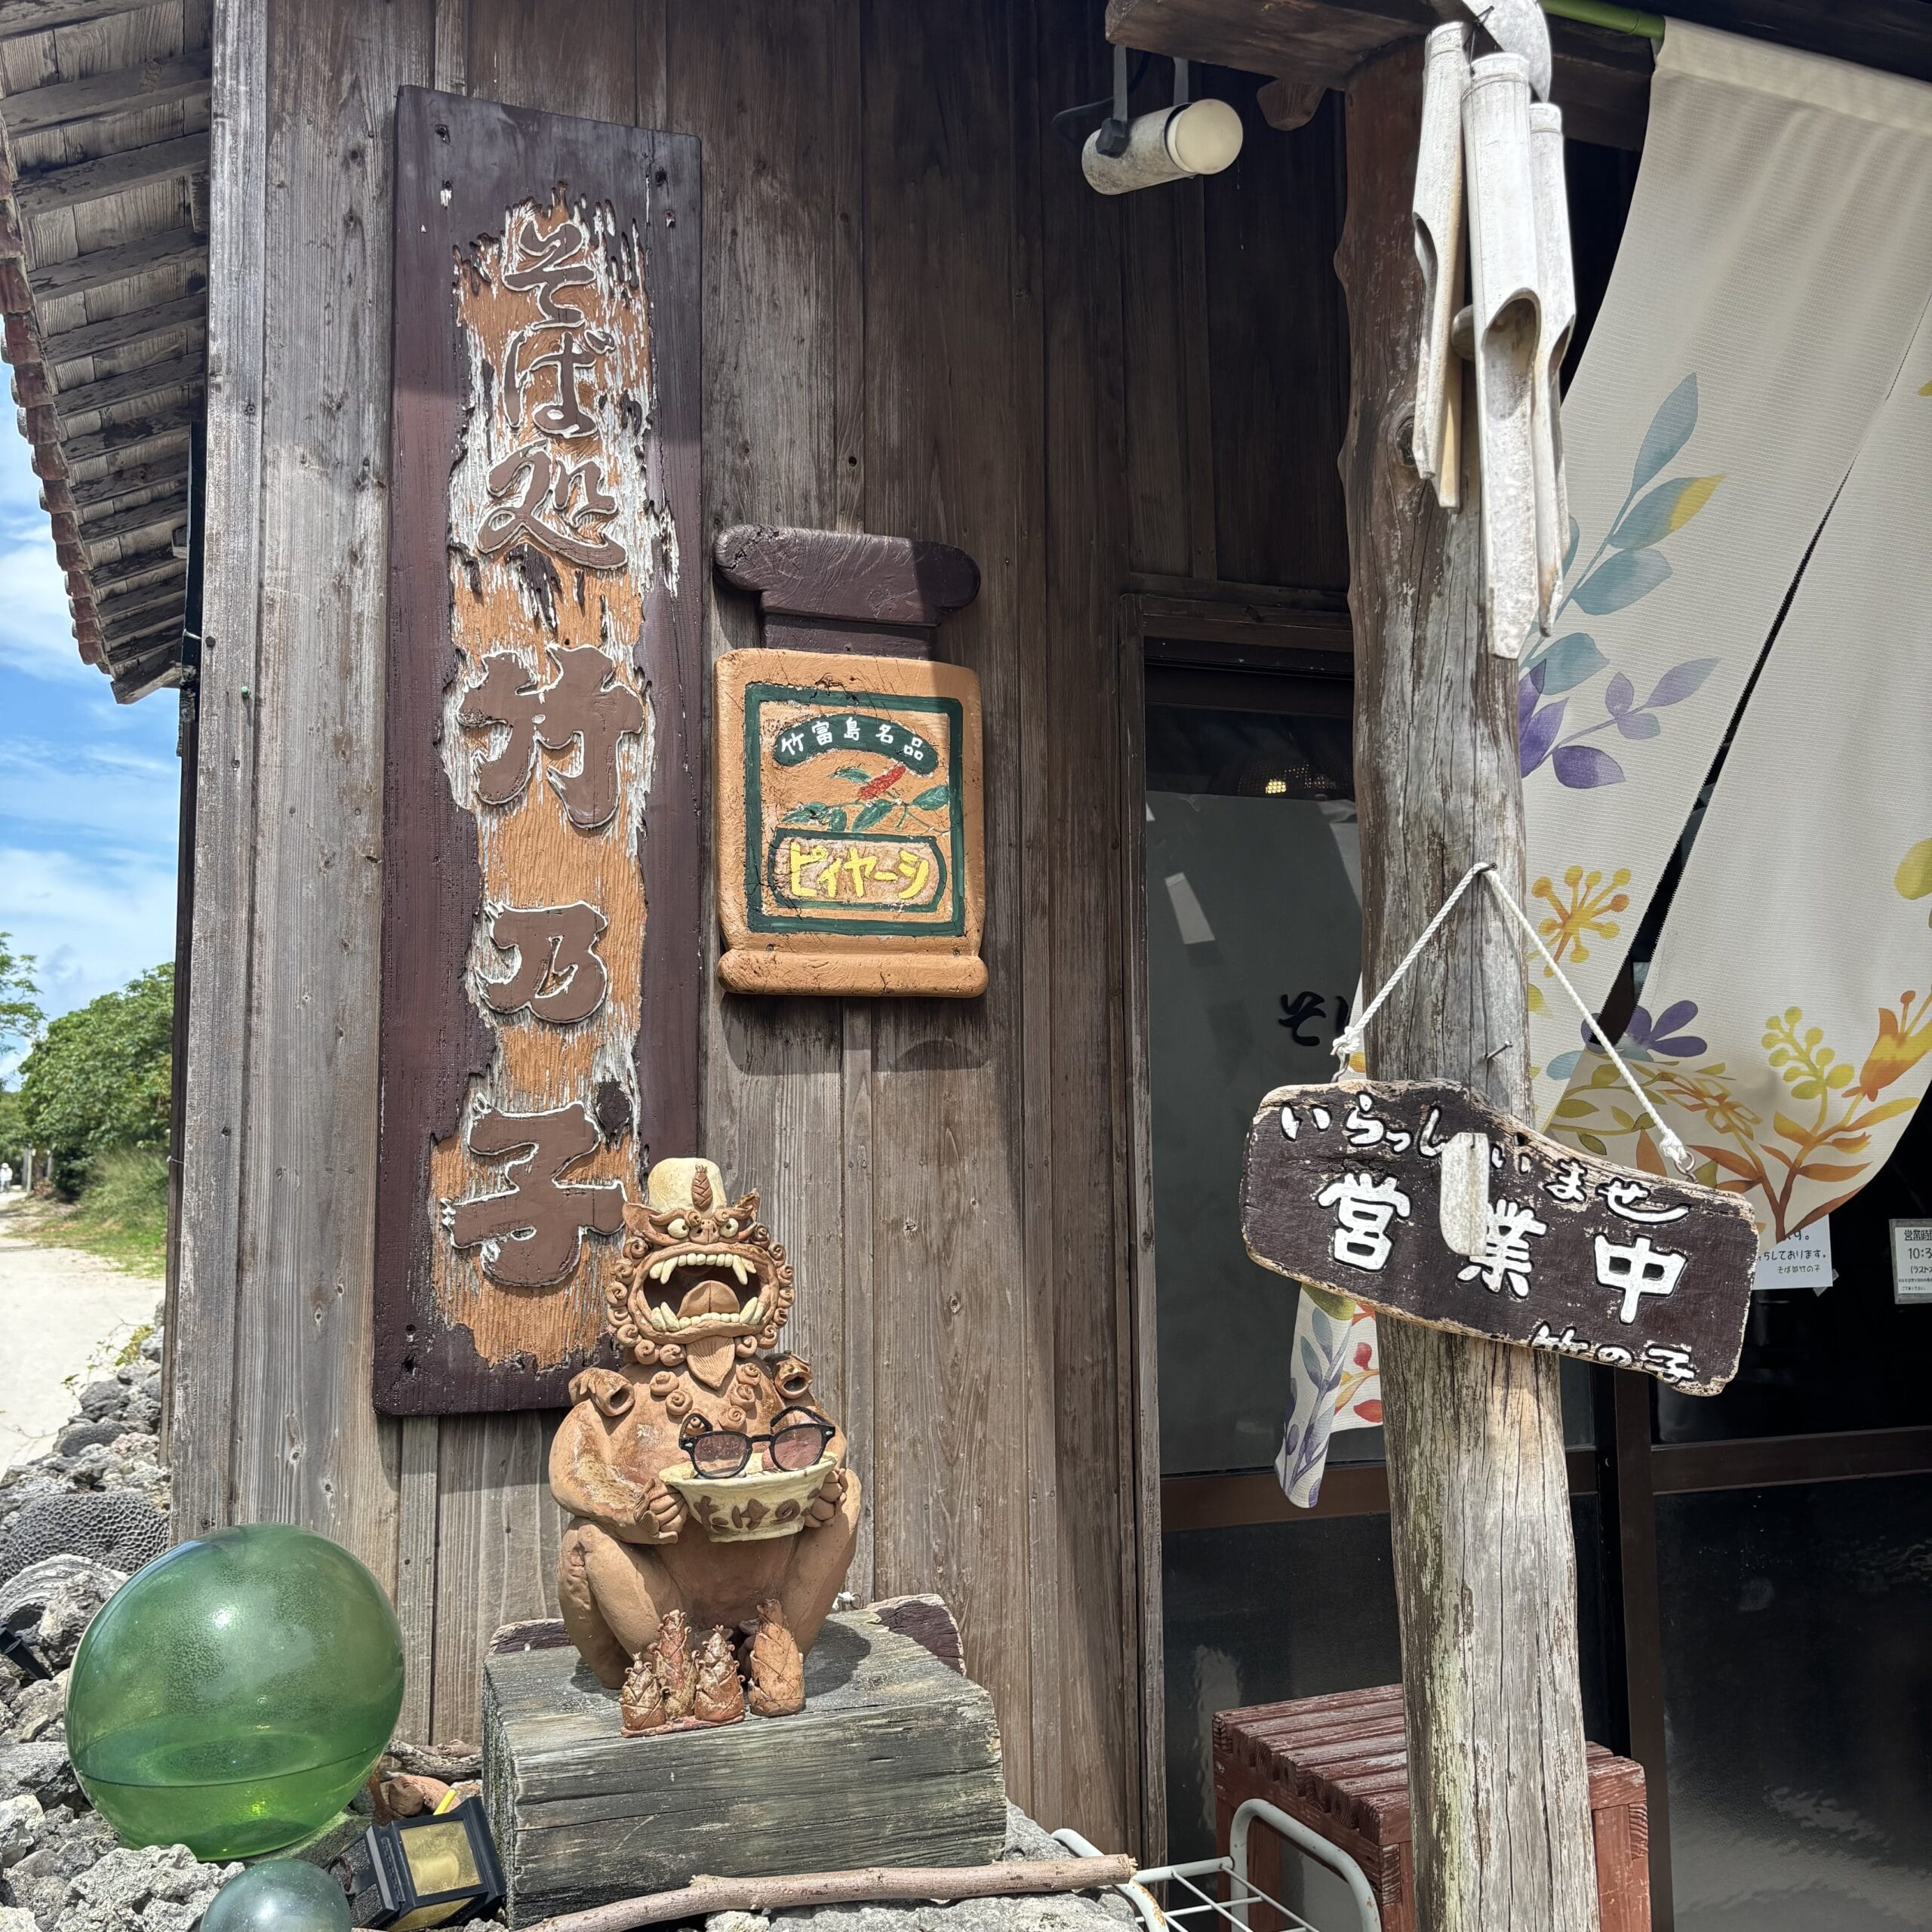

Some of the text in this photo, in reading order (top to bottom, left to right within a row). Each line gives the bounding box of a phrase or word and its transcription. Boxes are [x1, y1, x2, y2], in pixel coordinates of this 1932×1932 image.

[441, 219, 644, 1287] そば処竹乃子
[780, 716, 924, 761] 竹富島名品
[1281, 1091, 1692, 1226] いらっしいませ
[1316, 1171, 1689, 1327] 営業中
[1758, 1249, 1827, 1261] らしております。
[1903, 1229, 1932, 1241] 営業時
